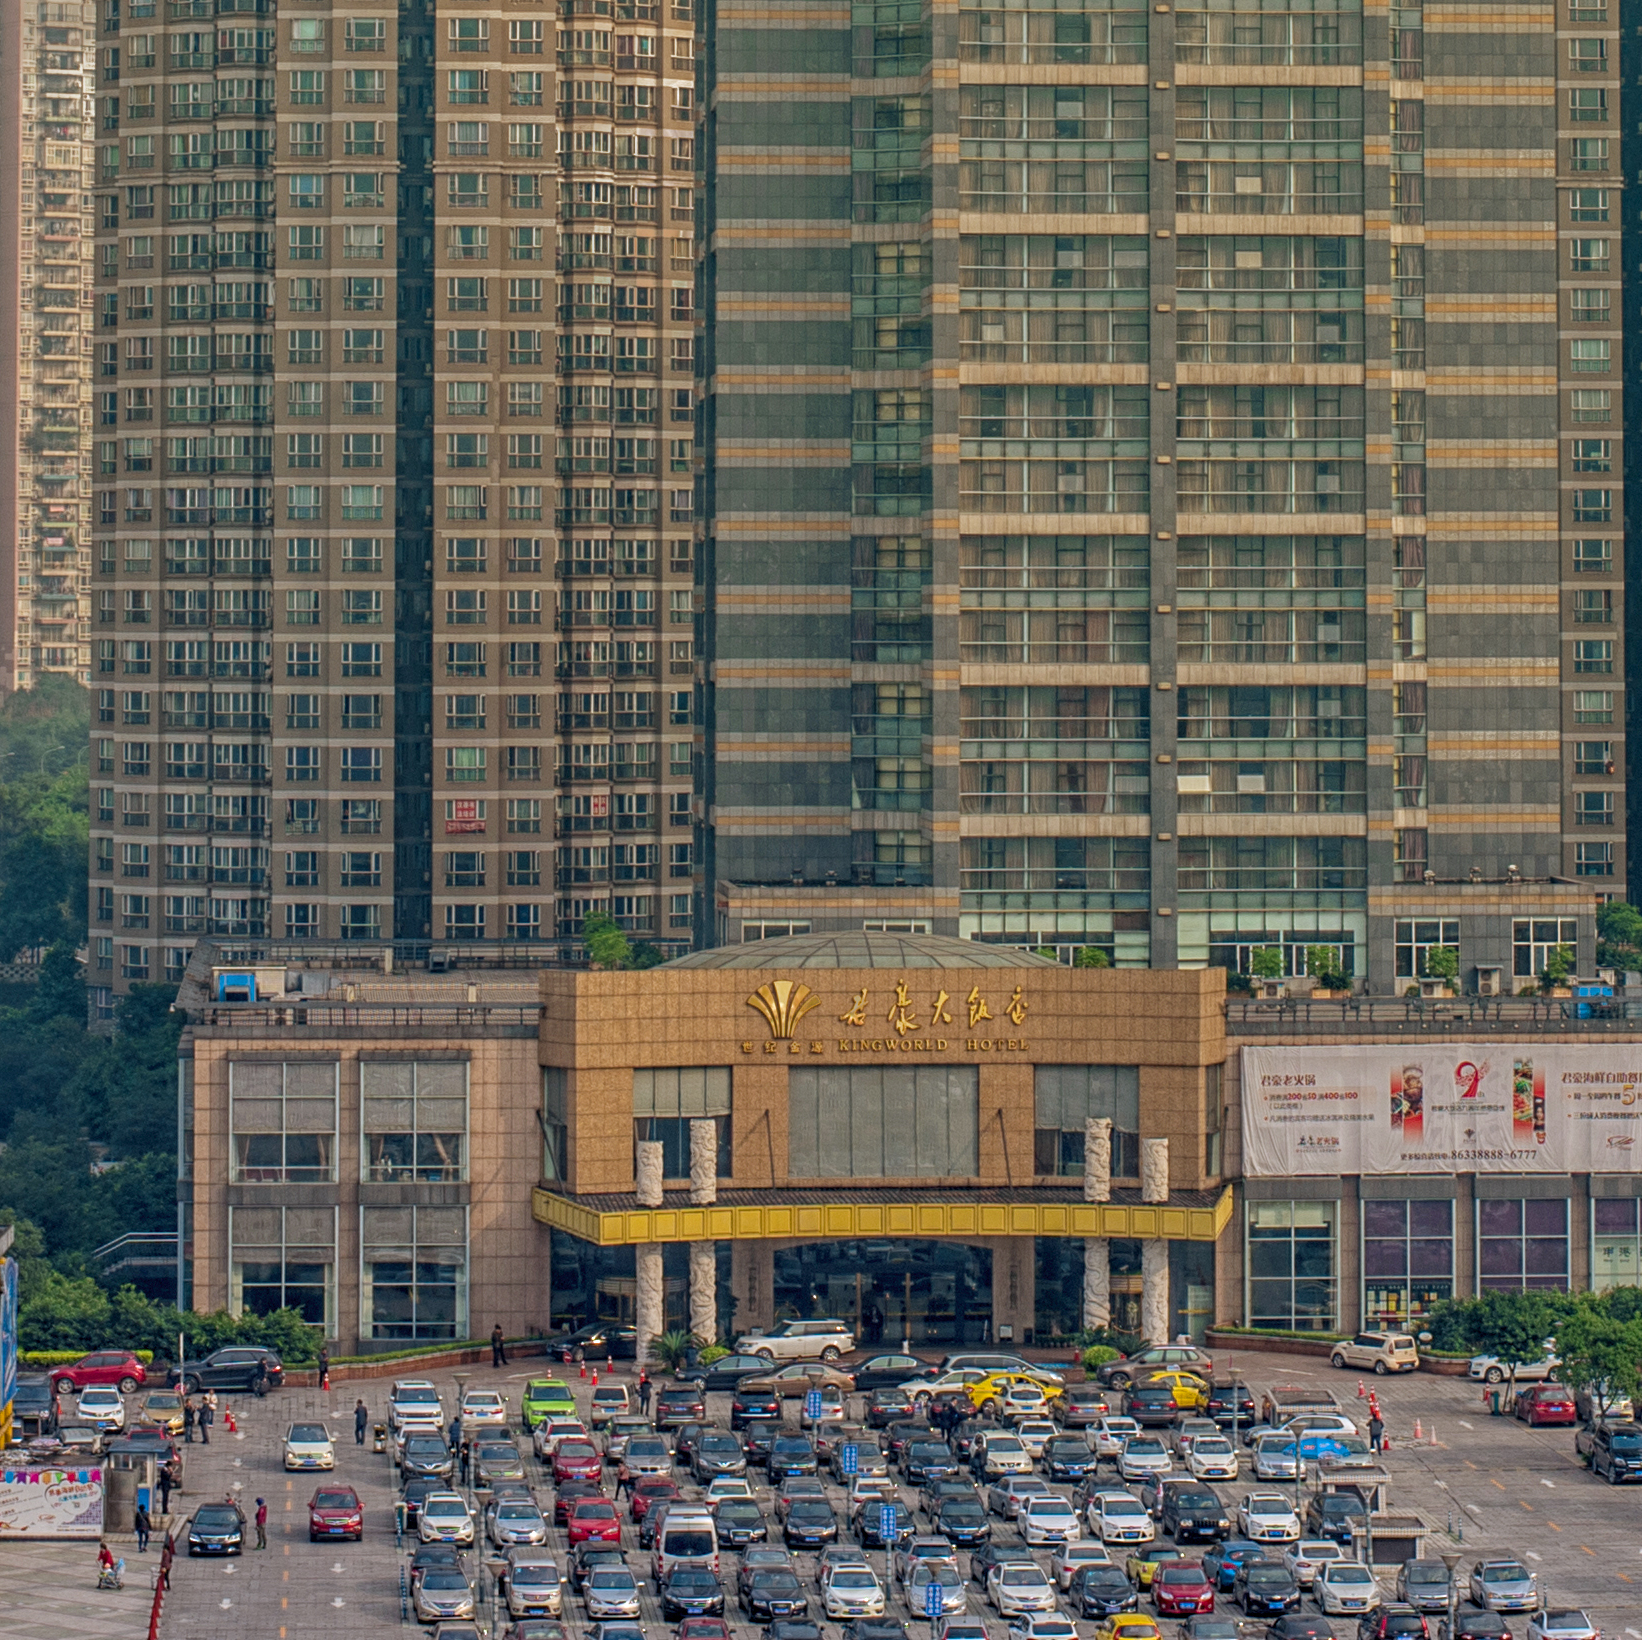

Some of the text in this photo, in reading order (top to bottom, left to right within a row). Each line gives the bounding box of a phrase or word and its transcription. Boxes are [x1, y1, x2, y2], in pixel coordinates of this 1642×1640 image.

[839, 1039, 1030, 1052] KINGWORLD HOTEL
[1451, 1149, 1538, 1161] 86338888-6777
